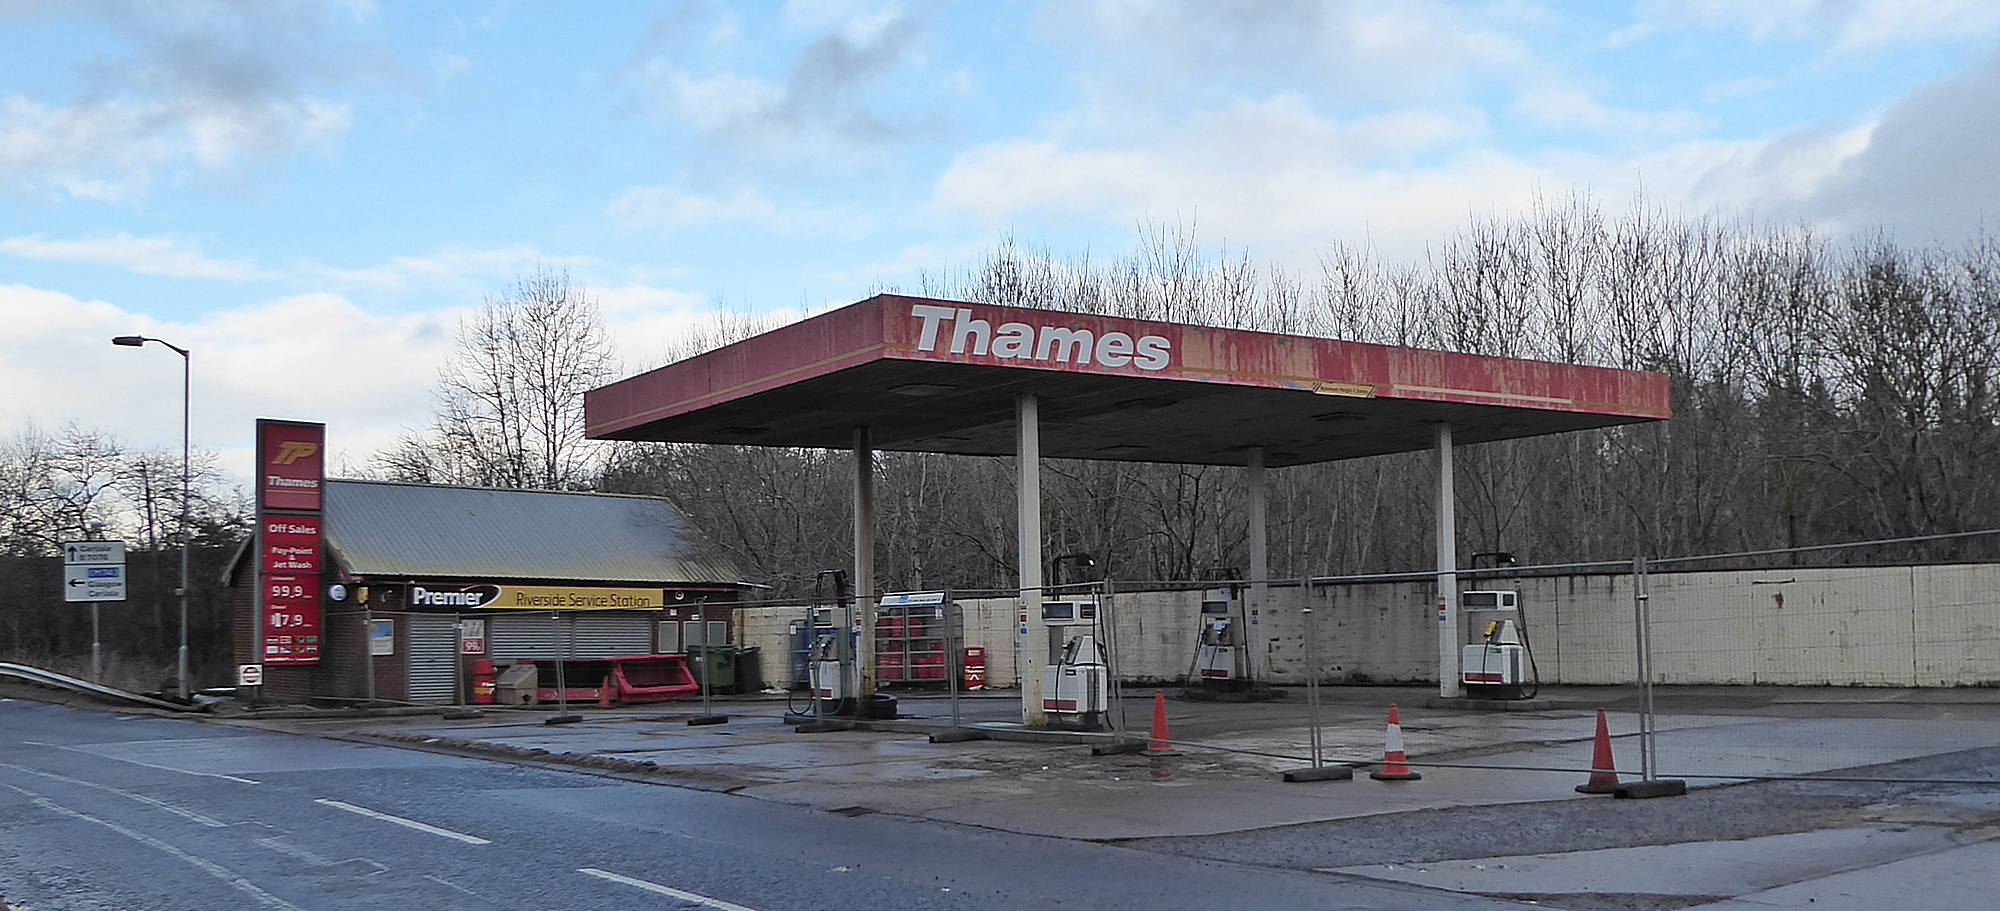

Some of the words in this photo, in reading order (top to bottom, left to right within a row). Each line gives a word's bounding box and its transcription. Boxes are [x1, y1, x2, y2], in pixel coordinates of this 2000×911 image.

[911, 304, 1171, 371] Thames
[268, 475, 318, 488] Thames
[269, 524, 287, 533] Off
[288, 524, 316, 534] Sales
[288, 561, 313, 569] Wash
[414, 587, 484, 605] Premier
[516, 592, 566, 607] Riverside
[568, 593, 608, 608] Service
[609, 594, 651, 608] Station
